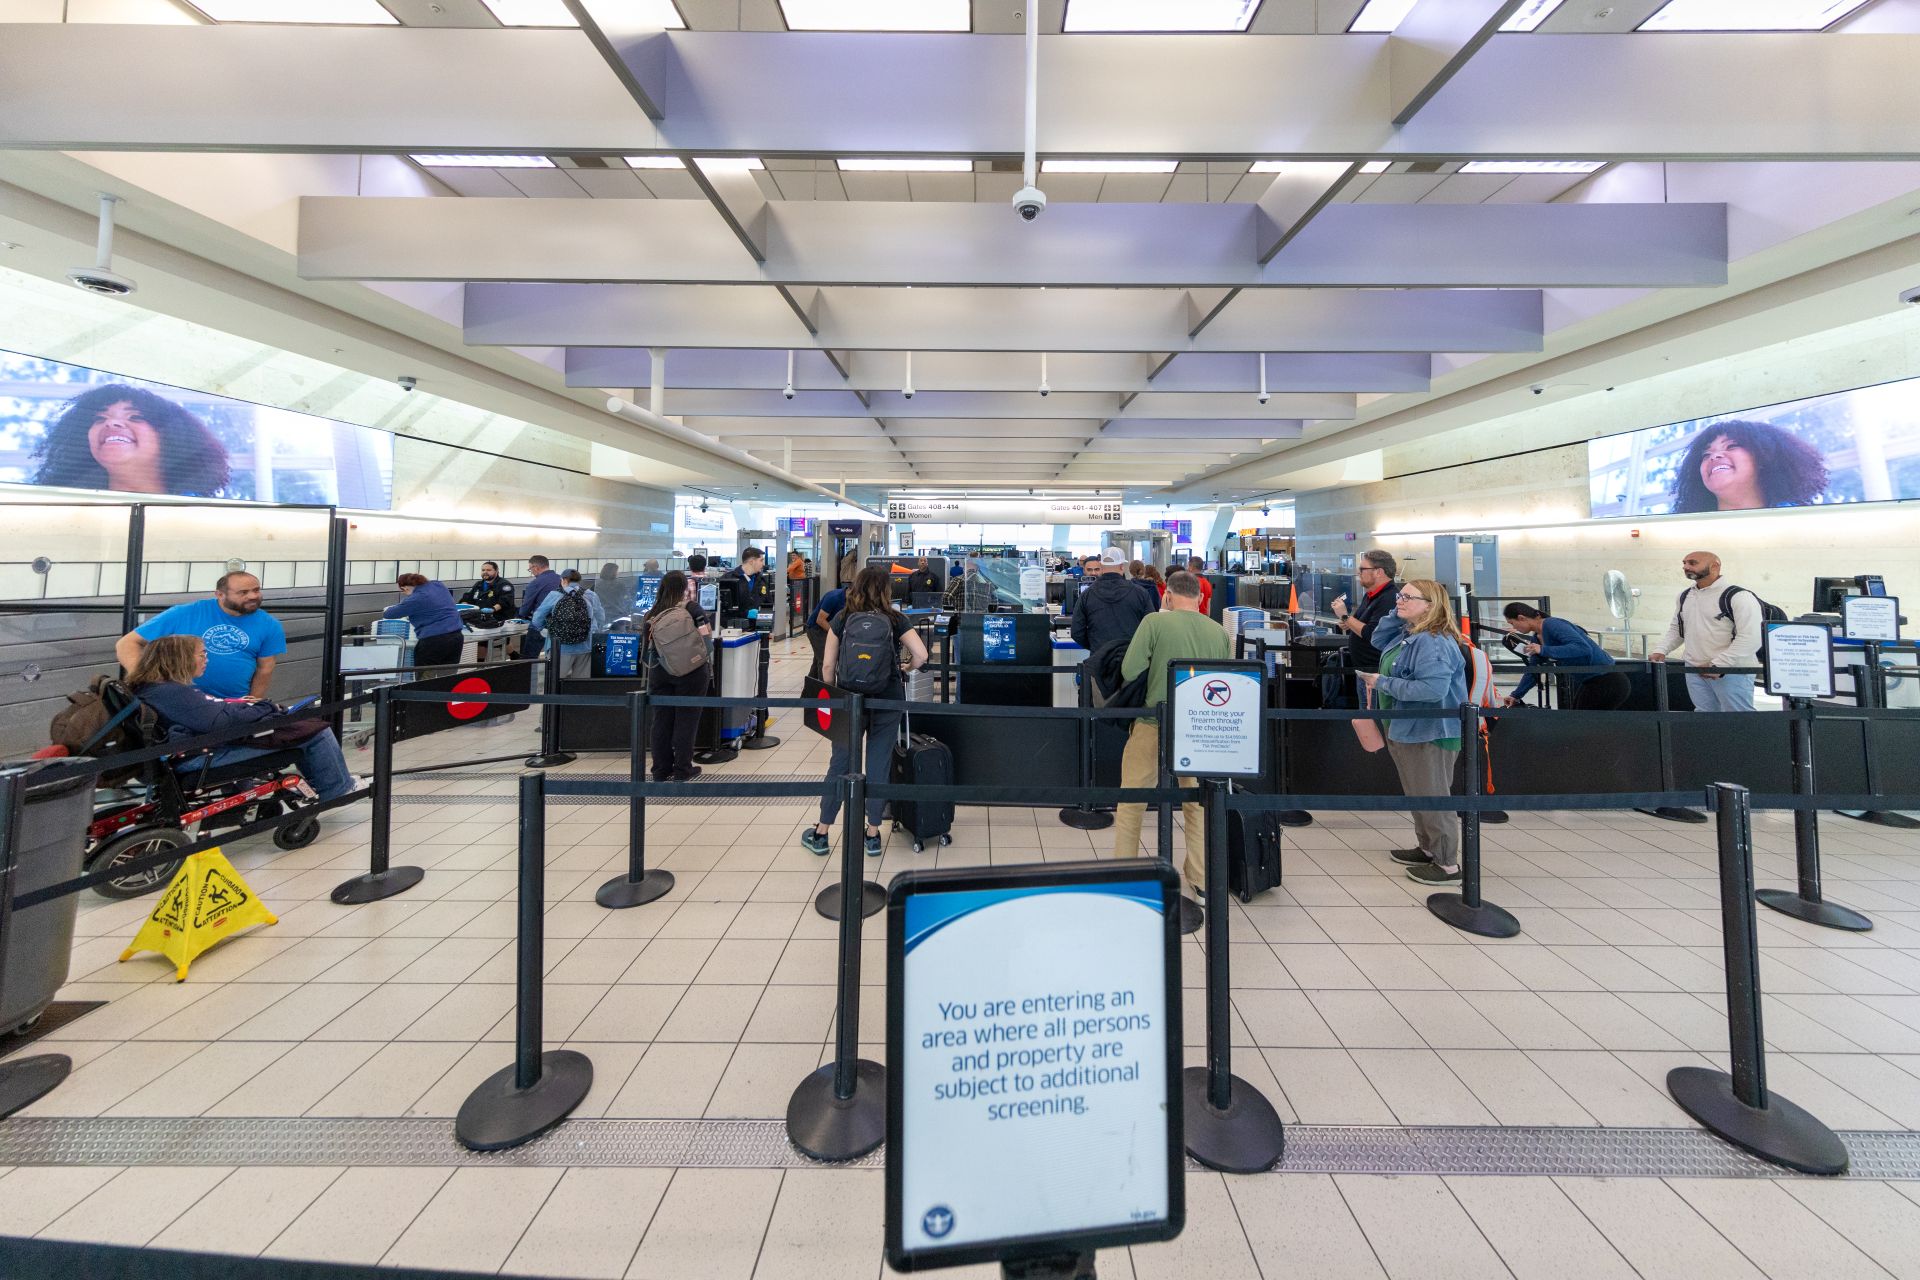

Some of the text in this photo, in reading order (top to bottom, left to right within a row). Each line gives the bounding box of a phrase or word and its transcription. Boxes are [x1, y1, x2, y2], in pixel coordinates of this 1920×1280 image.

[1216, 717, 1243, 725] through
[159, 881, 180, 909] CAUTION
[219, 874, 243, 895] CUIDADO
[195, 883, 209, 916] CAUTION
[201, 904, 238, 927] ATTENTION
[938, 990, 1135, 1021] You are entering an
[922, 1013, 1151, 1049] area where all persons
[952, 1041, 1123, 1072] and property are
[935, 1061, 1139, 1100] subject to additional
[988, 1094, 1089, 1120] screening.
